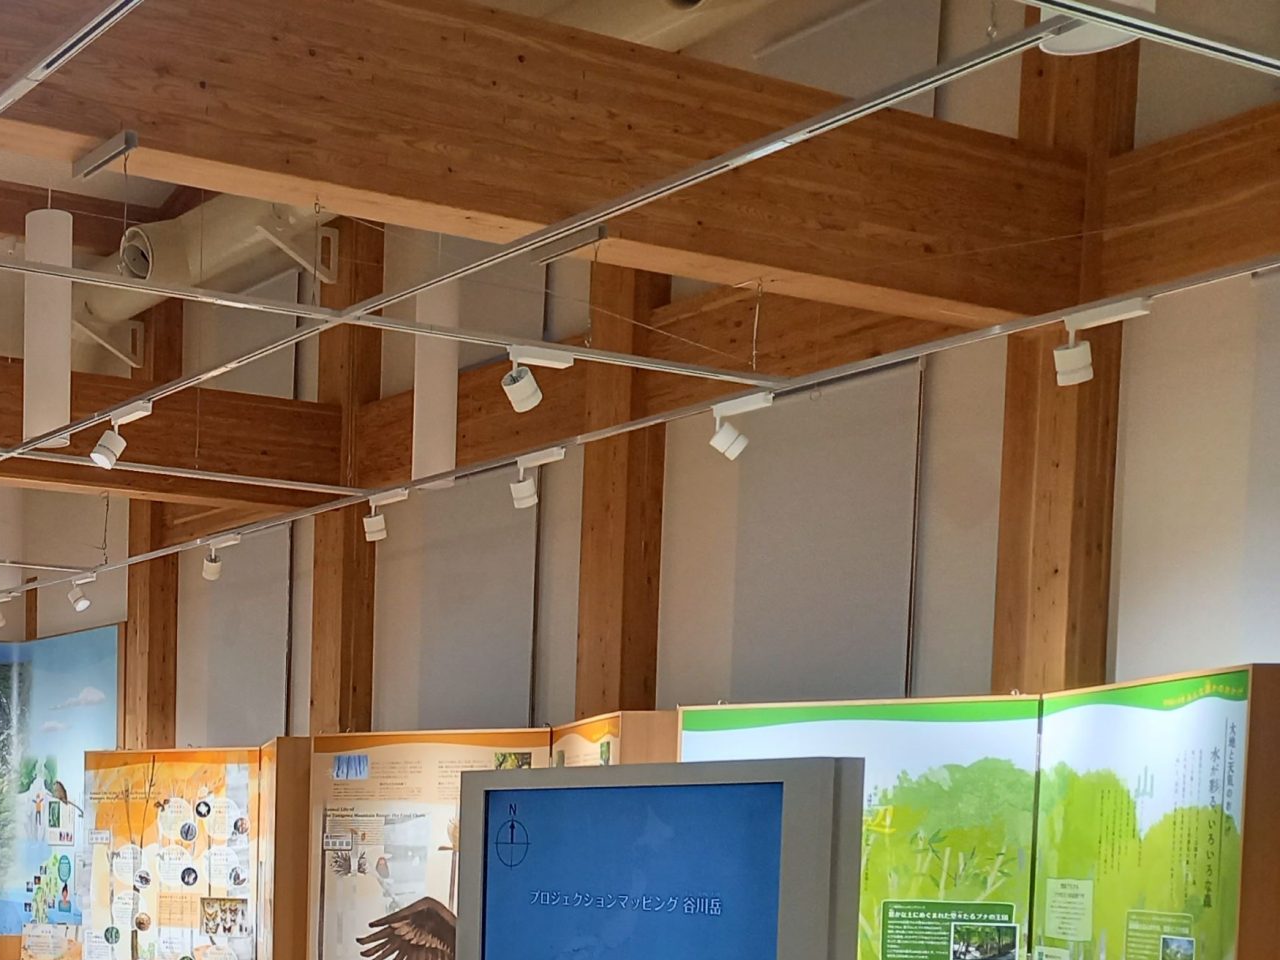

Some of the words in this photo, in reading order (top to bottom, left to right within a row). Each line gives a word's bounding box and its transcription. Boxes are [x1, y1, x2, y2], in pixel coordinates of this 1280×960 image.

[508, 803, 517, 816] N
[530, 890, 678, 912] プロジェクションマッピング
[683, 896, 722, 915] 谷川岳
